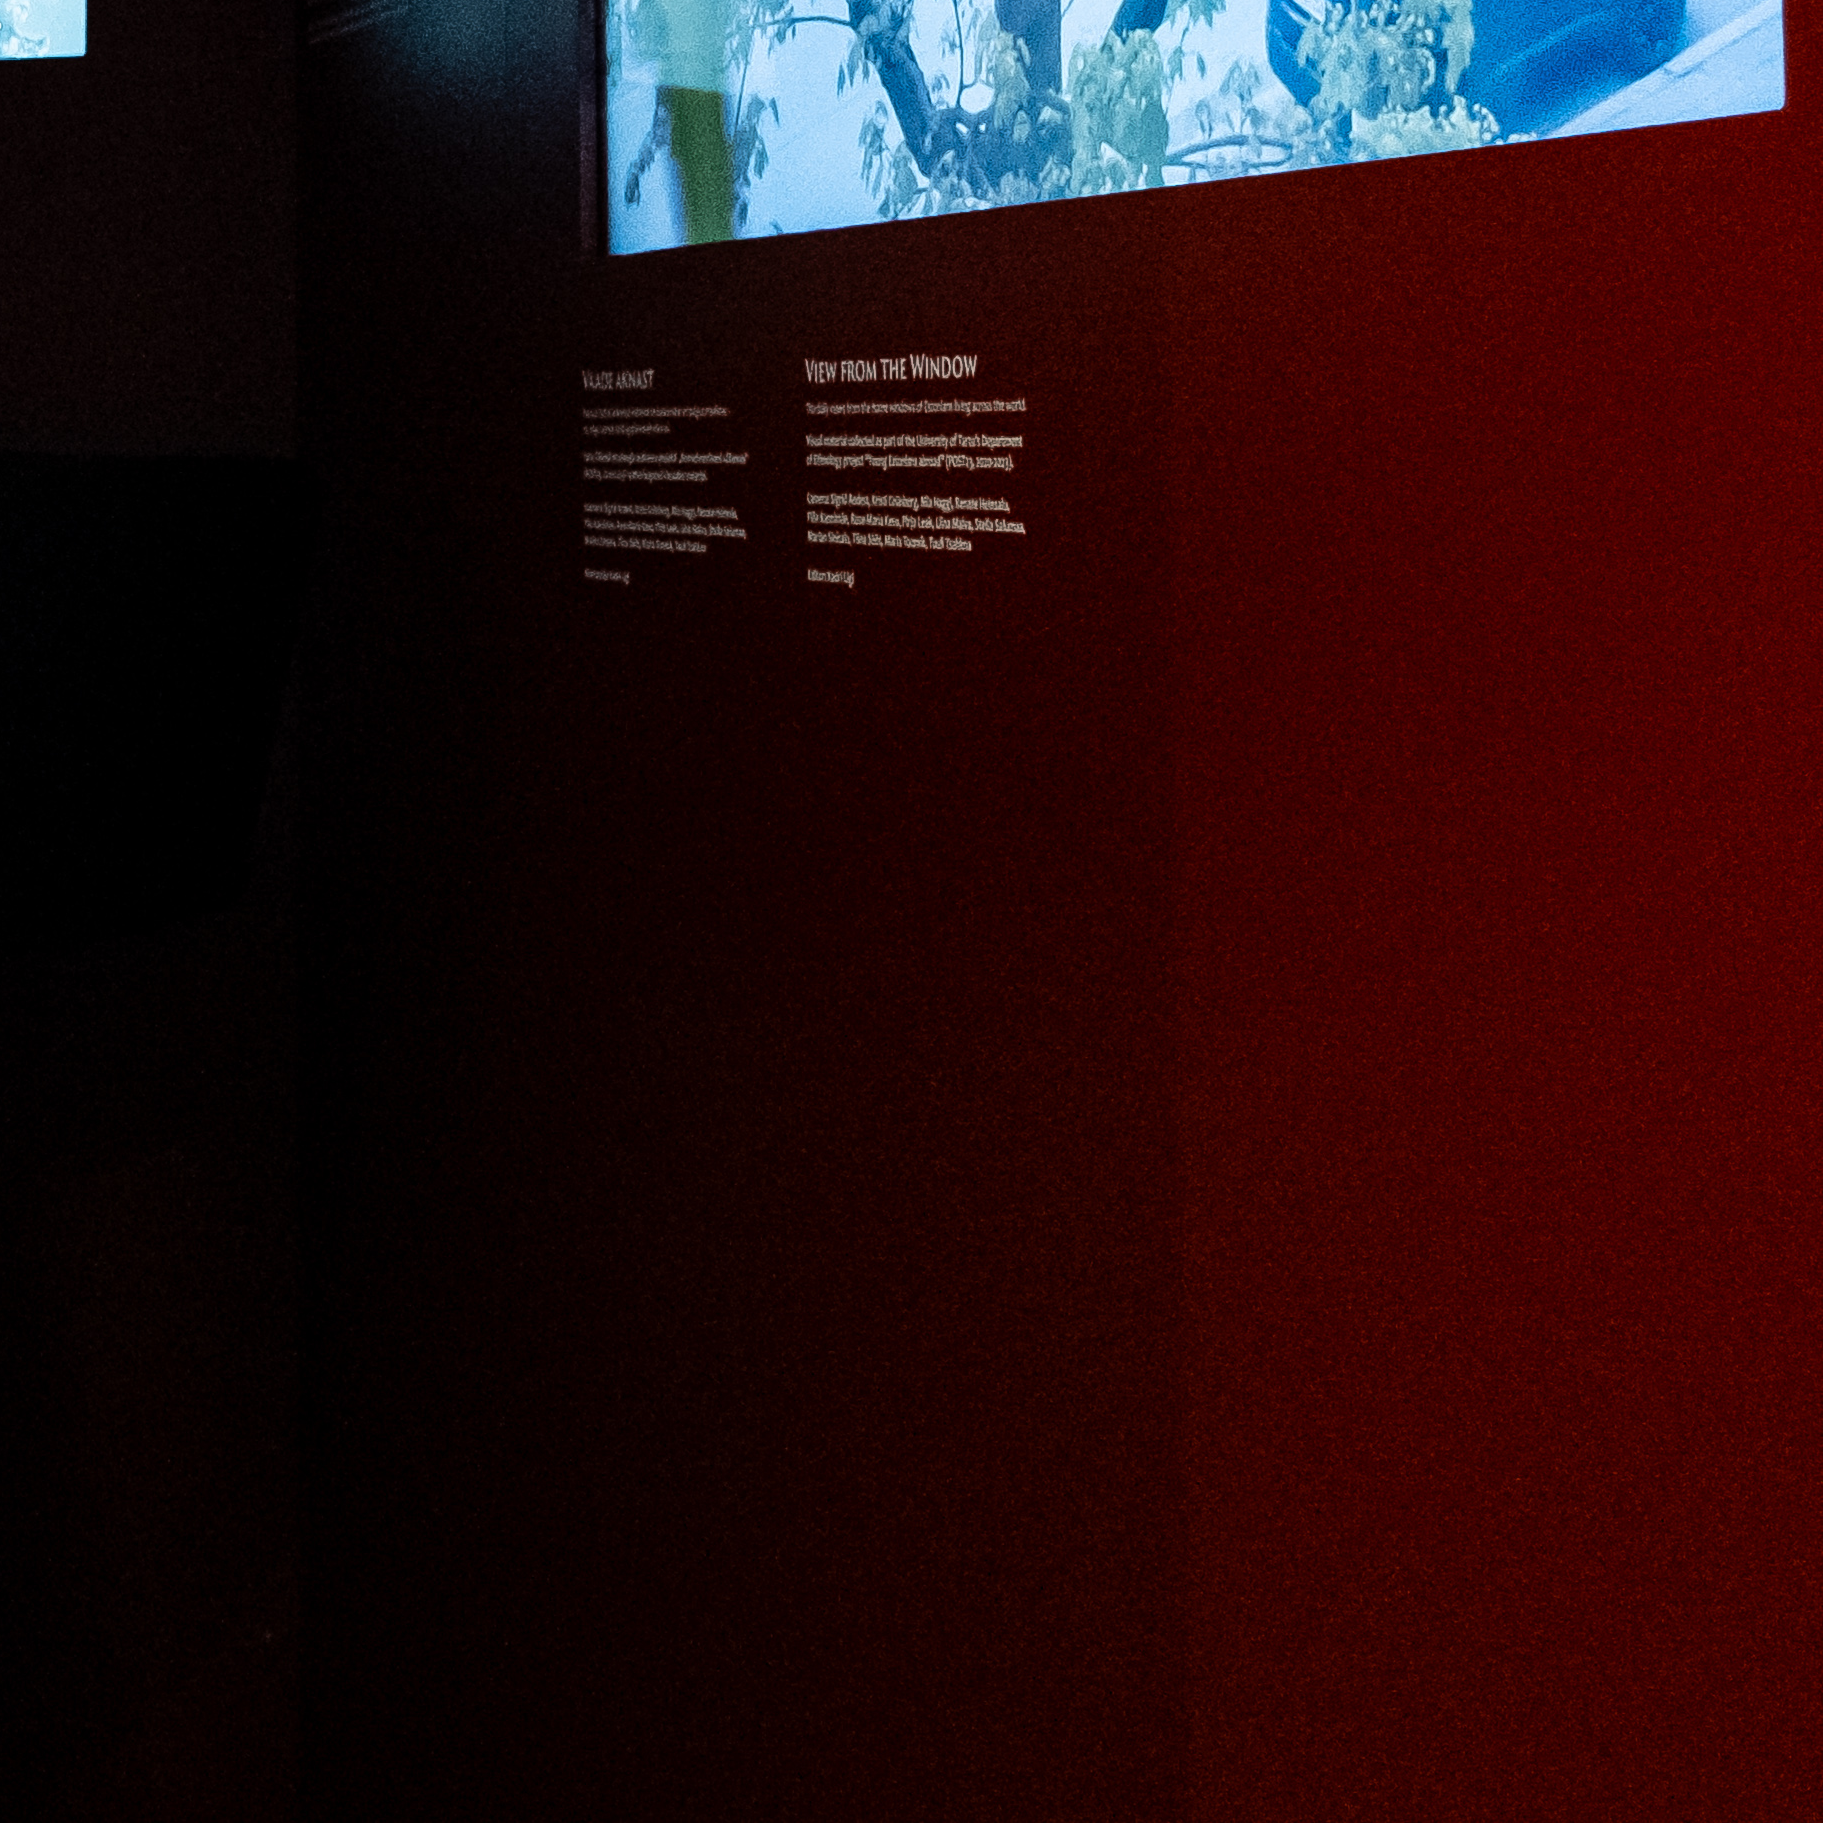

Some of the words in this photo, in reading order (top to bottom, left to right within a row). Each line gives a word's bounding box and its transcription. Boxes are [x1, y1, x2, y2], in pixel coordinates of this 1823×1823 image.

[804, 358, 838, 384] VIEW
[840, 359, 877, 382] FROM
[880, 358, 907, 380] THE
[909, 353, 978, 380] WINDOW
